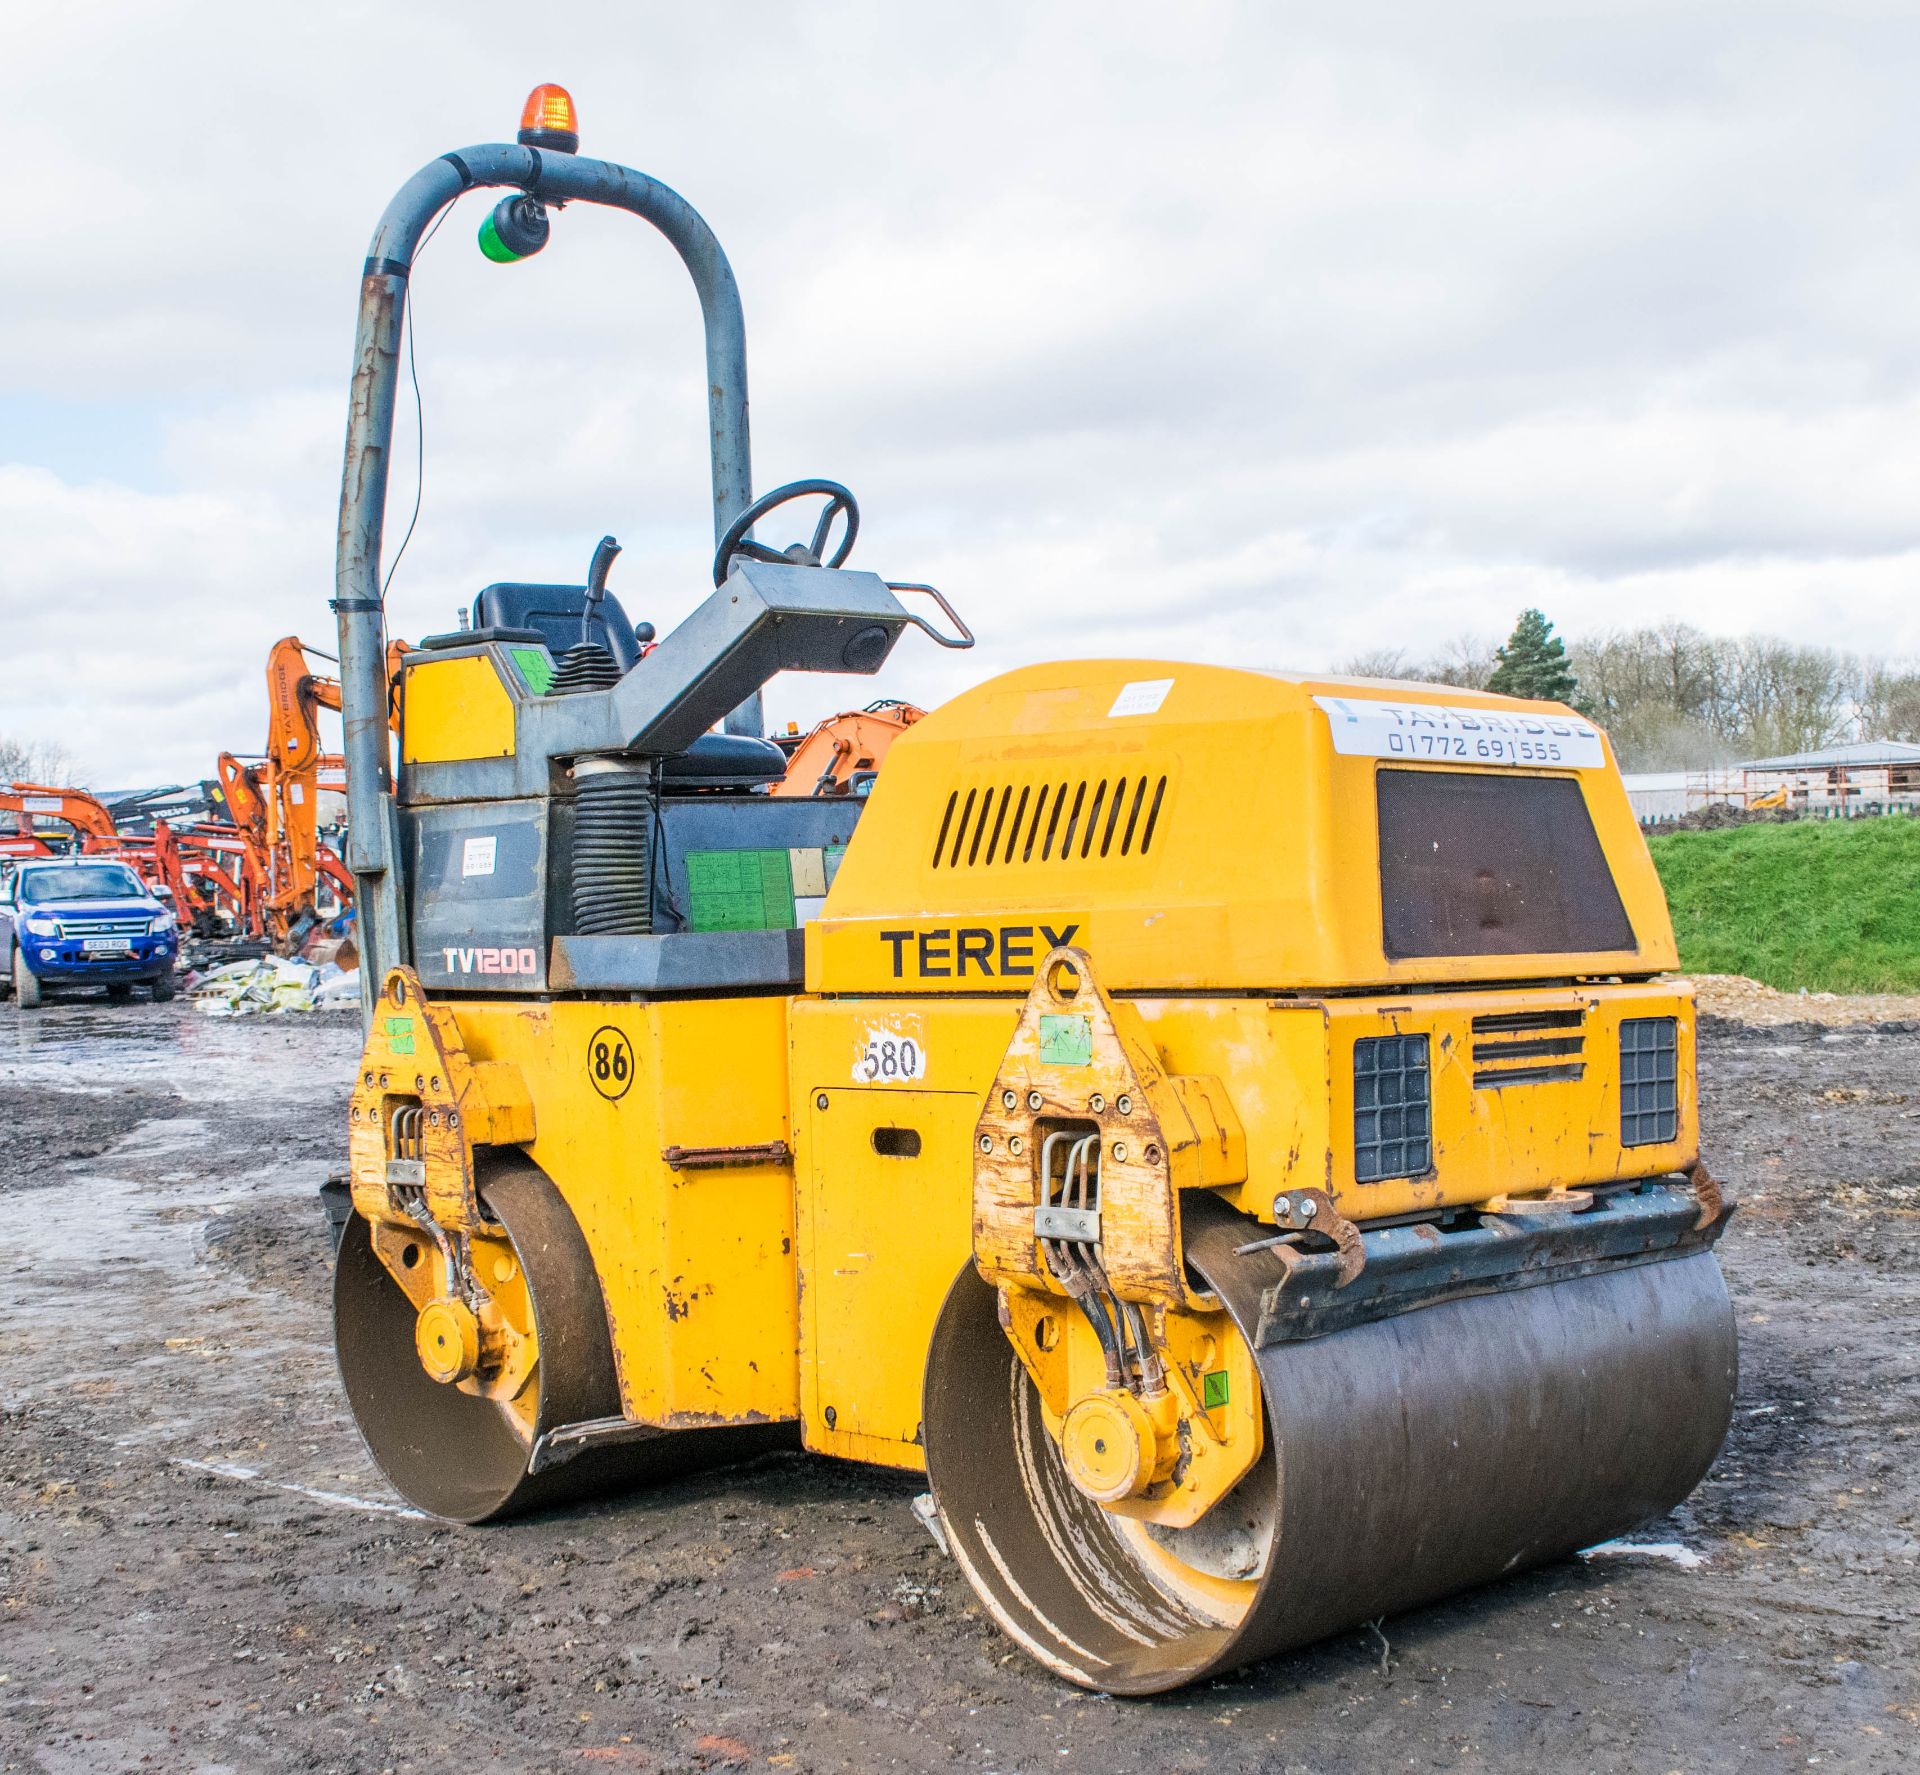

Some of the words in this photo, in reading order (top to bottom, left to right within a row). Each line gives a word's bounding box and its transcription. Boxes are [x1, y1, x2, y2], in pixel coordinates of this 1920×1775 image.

[278, 664, 291, 735] TAYBRIDGE
[1382, 708, 1596, 738] TAYBRIDGE
[1388, 733, 1467, 756] 01772
[1477, 739, 1562, 761] 691555
[150, 806, 190, 818] VOLVO
[442, 947, 537, 974] TV1200
[880, 924, 1081, 977] TEREX
[595, 1042, 628, 1082] 86
[863, 1039, 917, 1079] 580
